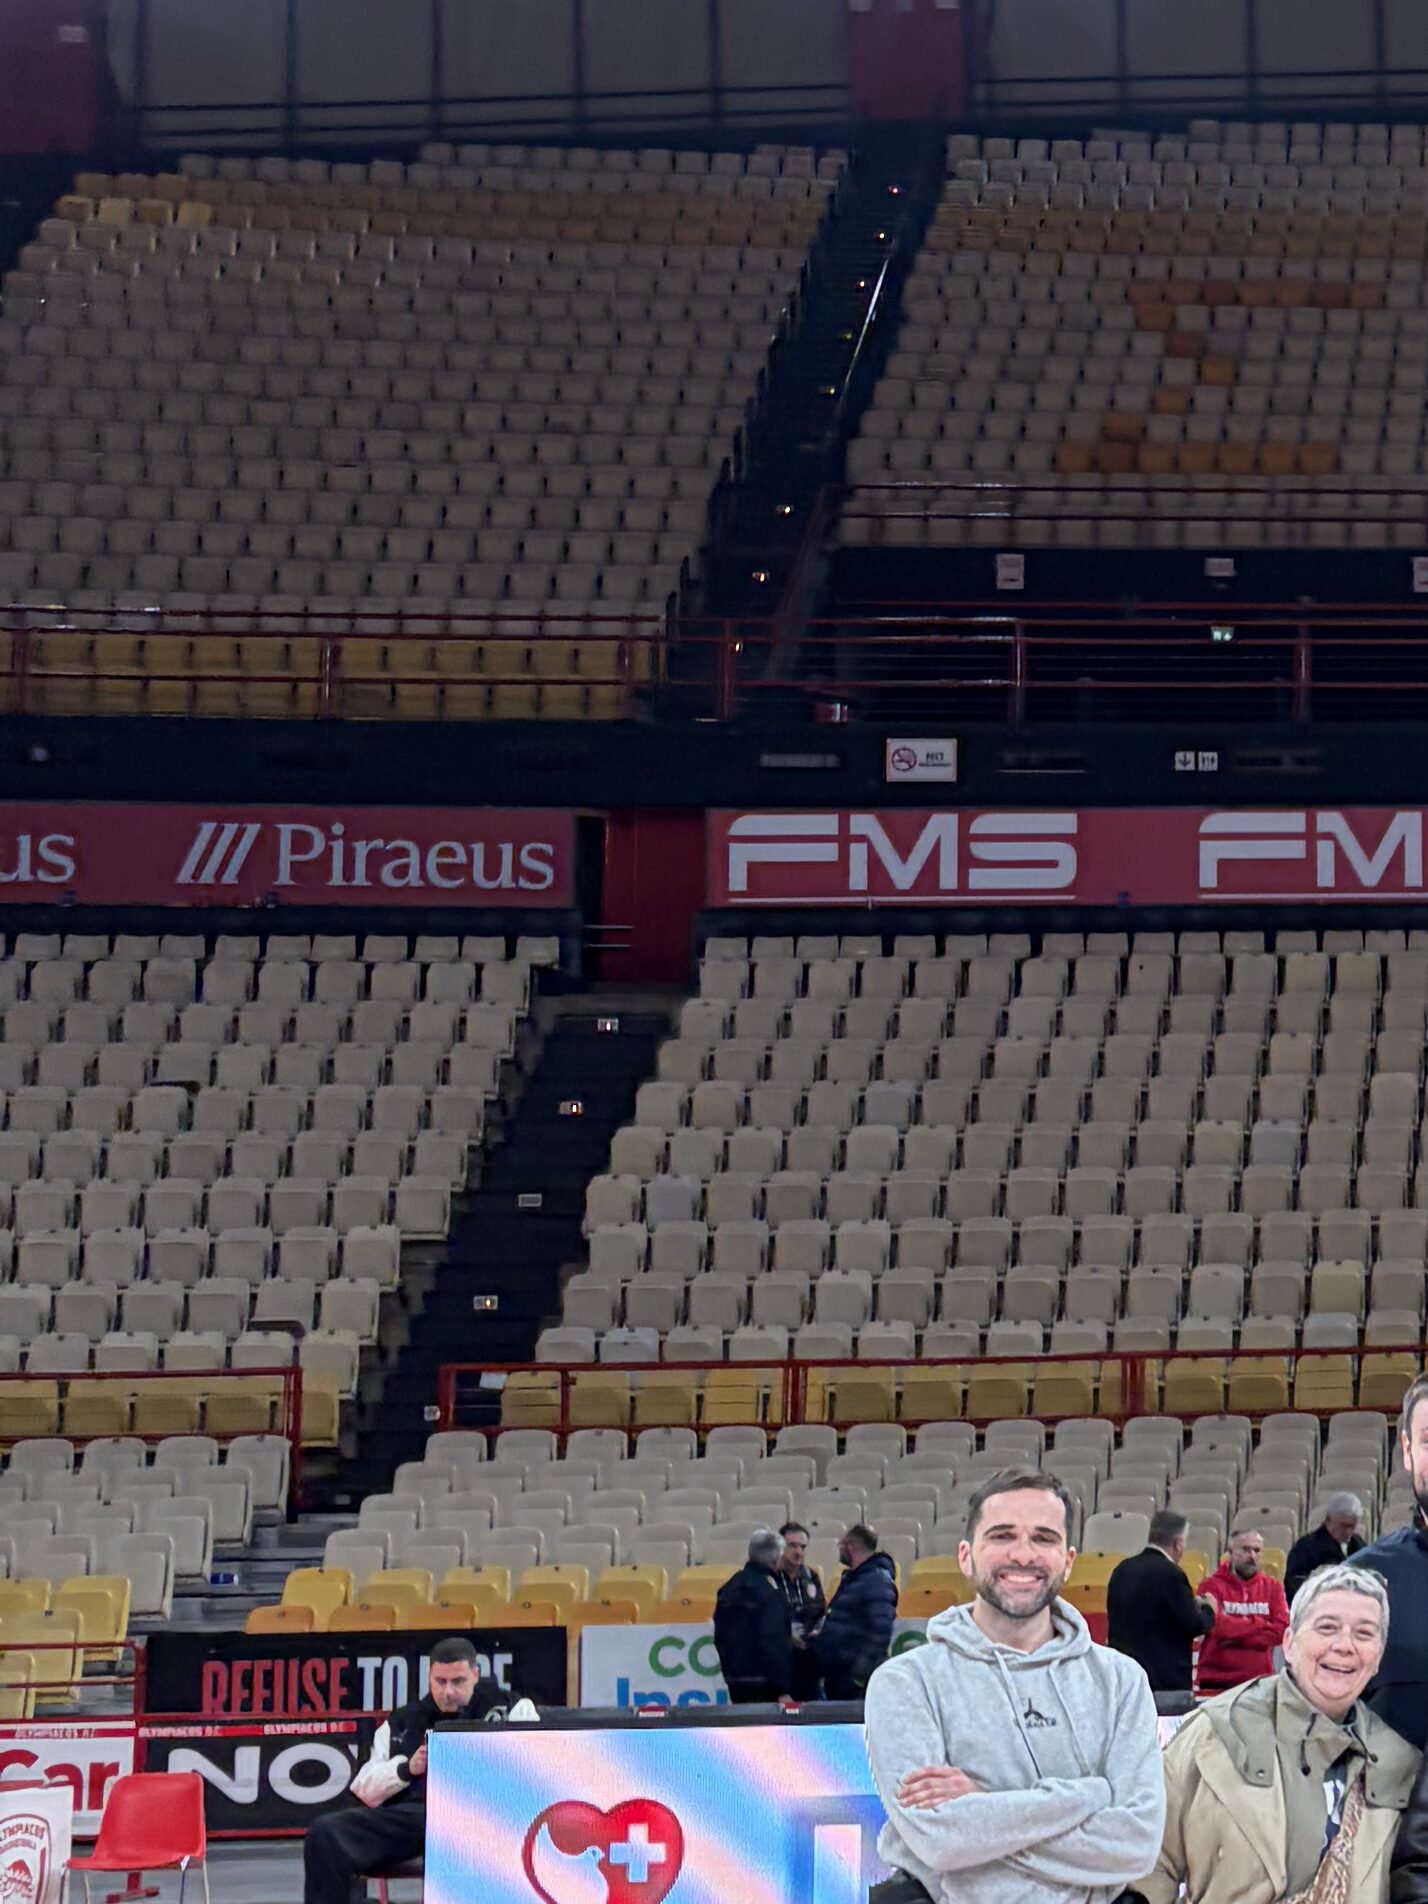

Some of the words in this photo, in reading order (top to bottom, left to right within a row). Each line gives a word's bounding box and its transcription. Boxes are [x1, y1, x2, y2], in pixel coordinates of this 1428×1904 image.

[273, 823, 555, 891] Piraeus
[728, 812, 1078, 892] FMS
[357, 1656, 408, 1711] TO
